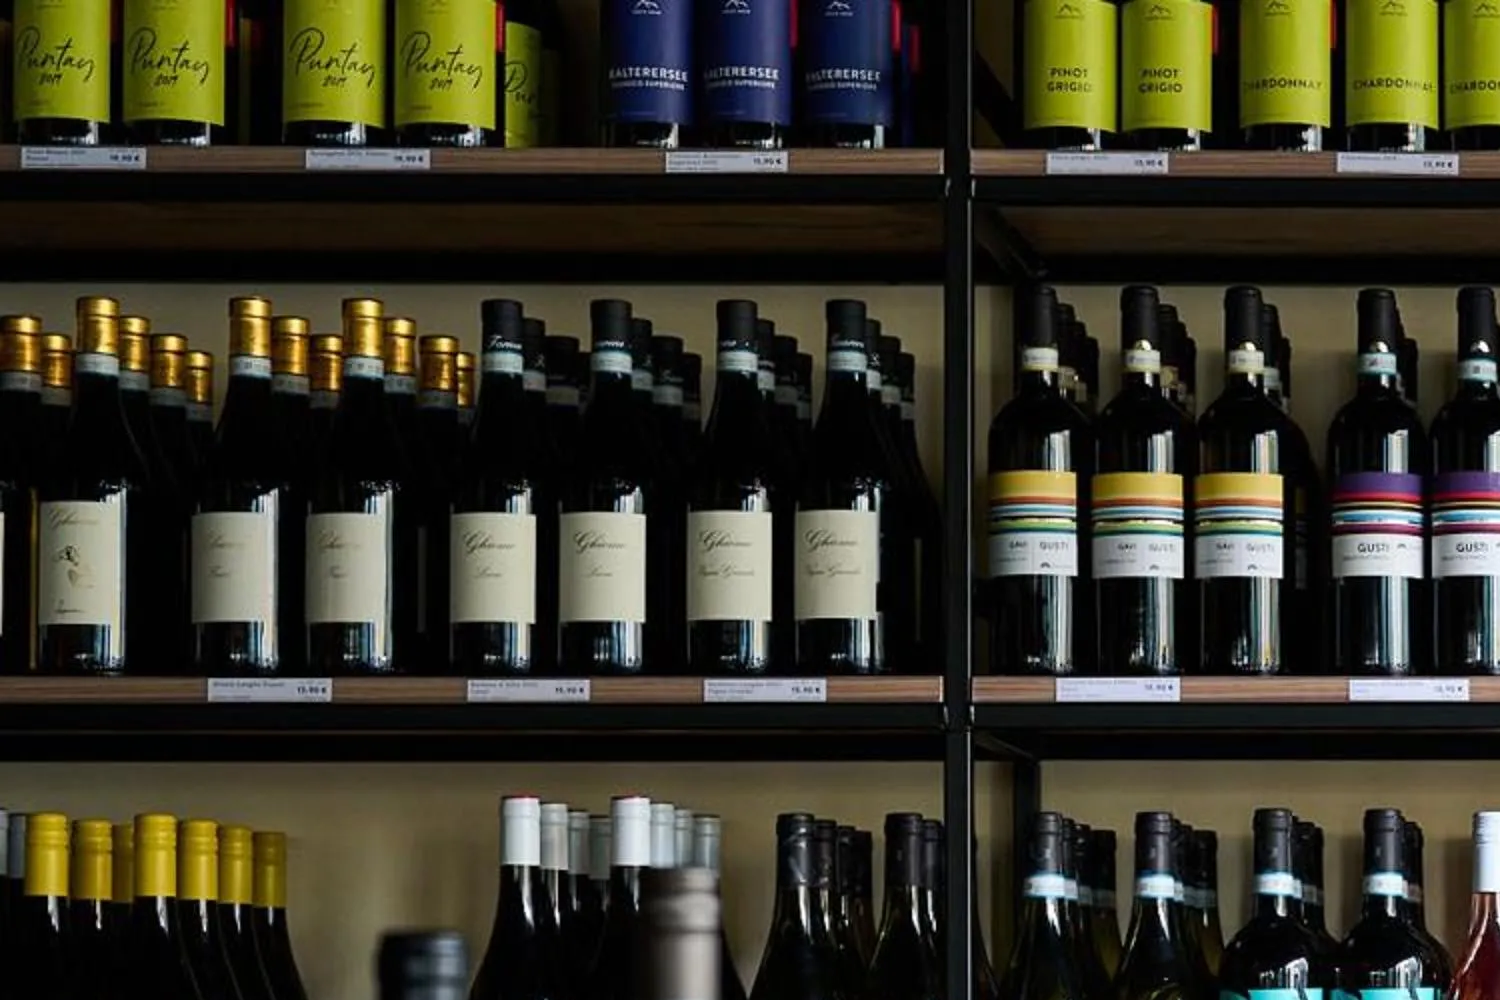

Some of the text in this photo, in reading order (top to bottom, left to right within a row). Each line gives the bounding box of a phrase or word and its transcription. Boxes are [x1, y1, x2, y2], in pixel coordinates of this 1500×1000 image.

[1050, 67, 1088, 79] PINOT
[1141, 67, 1180, 79] PINOT
[1047, 81, 1092, 93] GRIGIO
[1138, 82, 1183, 94] GRIGIO
[1357, 543, 1390, 553] GUSTI
[1456, 543, 1489, 553] GUSTI
